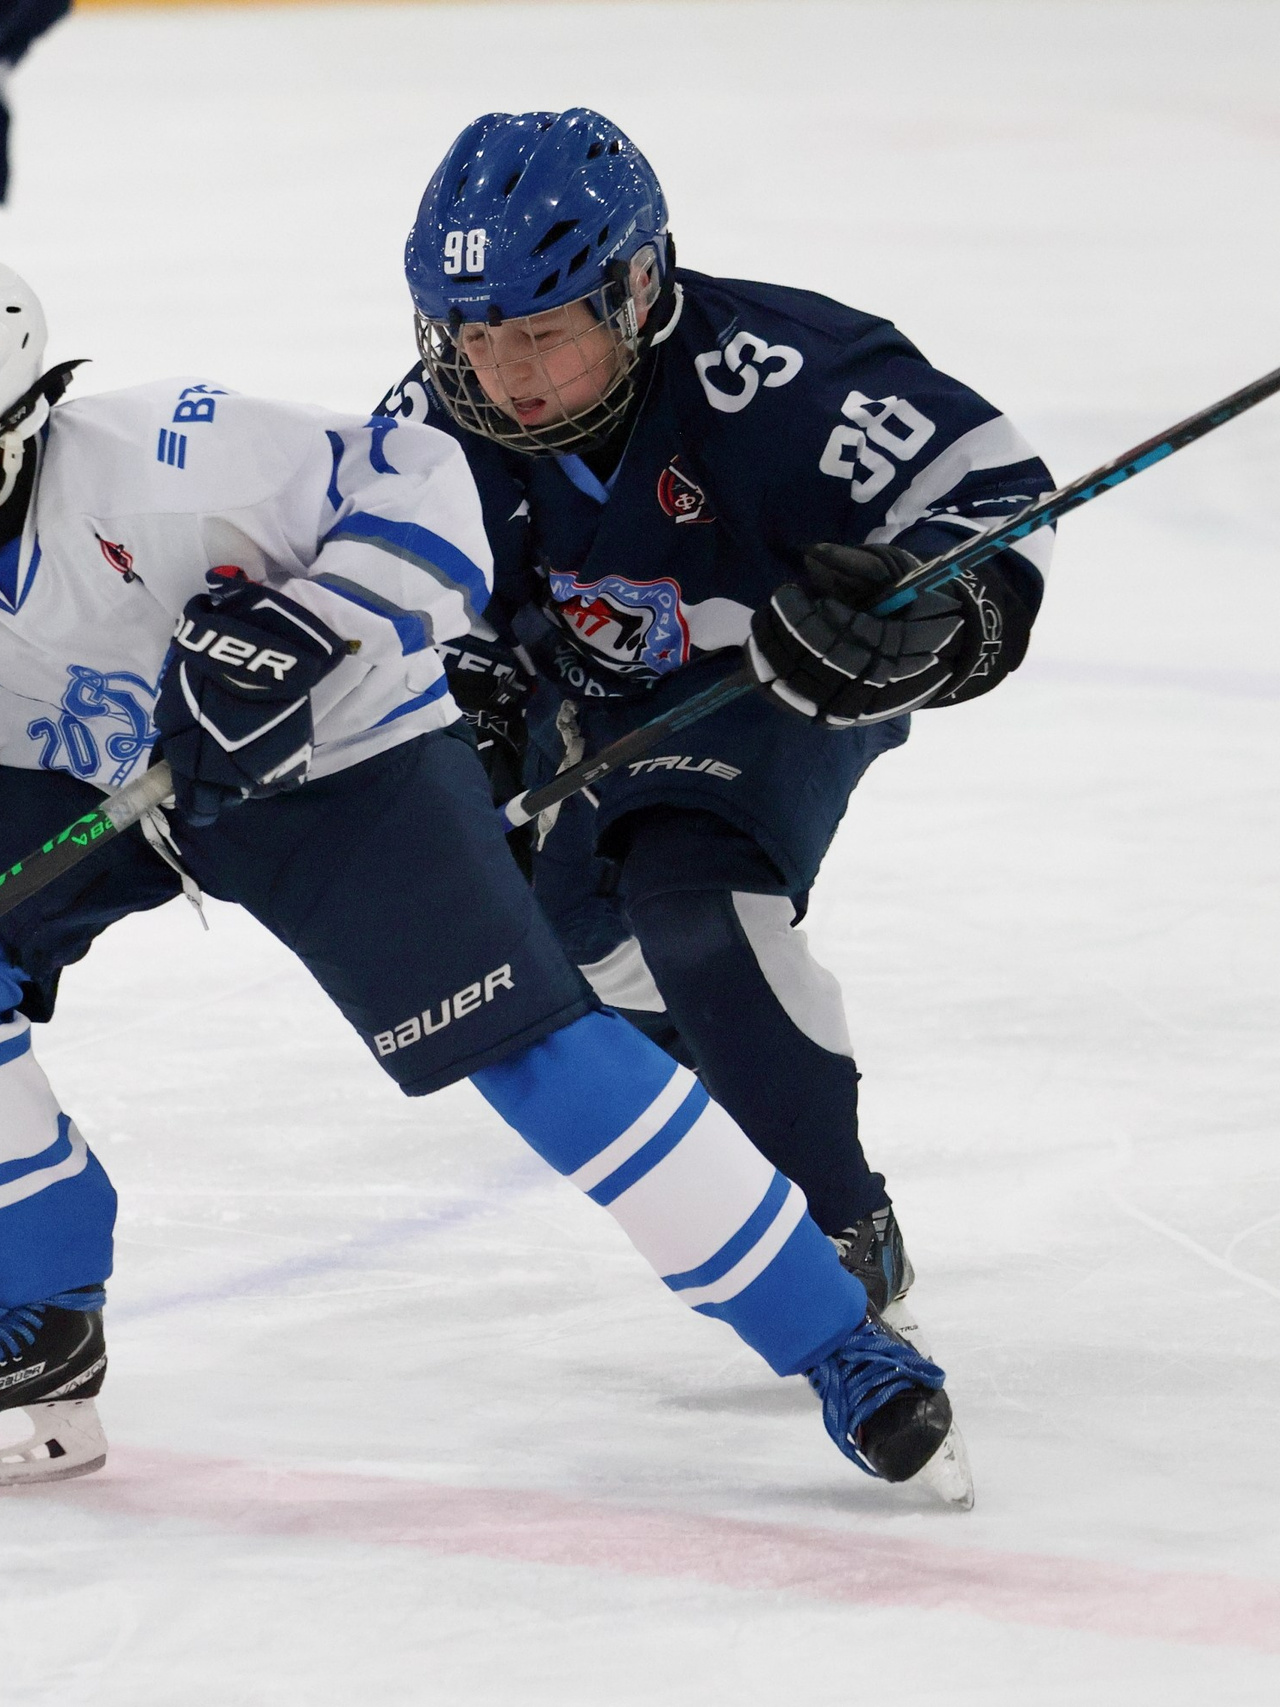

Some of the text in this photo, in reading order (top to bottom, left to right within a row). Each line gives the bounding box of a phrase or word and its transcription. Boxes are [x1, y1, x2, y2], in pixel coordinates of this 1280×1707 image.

[443, 228, 487, 275] 98
[447, 294, 491, 303] TRUE
[819, 390, 936, 503] 98
[173, 611, 298, 682] UER
[26, 713, 102, 779] 20
[628, 755, 743, 782] TRUE
[373, 962, 516, 1057] BAUER
